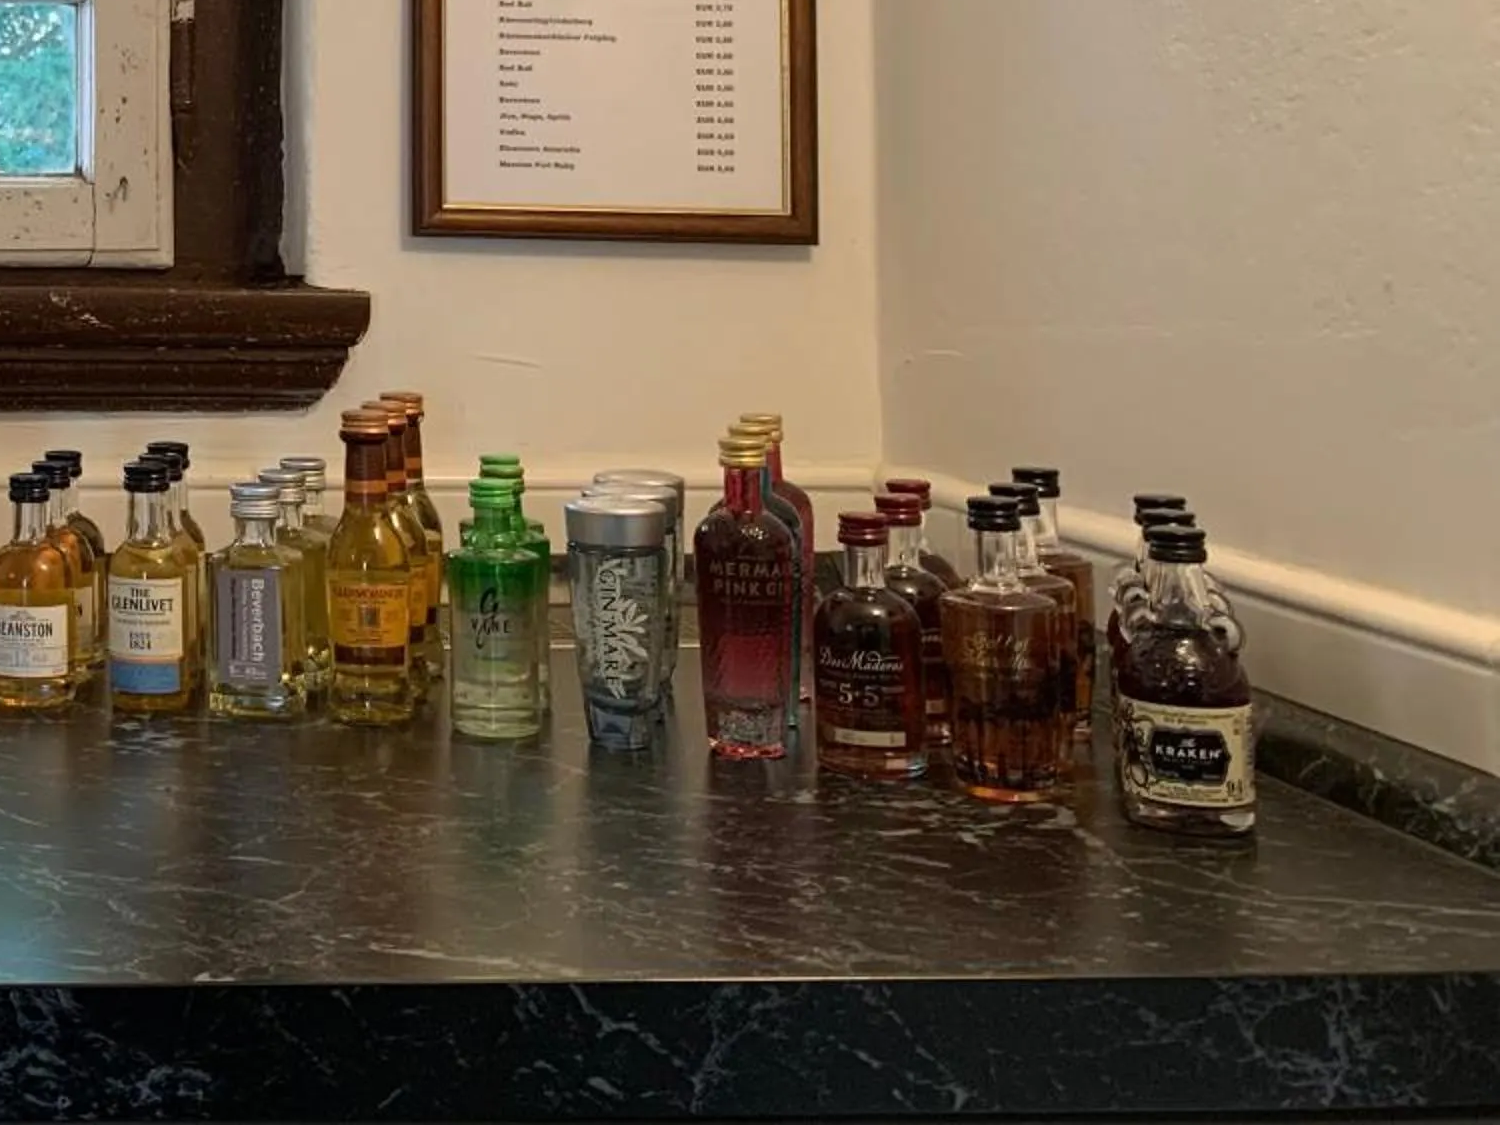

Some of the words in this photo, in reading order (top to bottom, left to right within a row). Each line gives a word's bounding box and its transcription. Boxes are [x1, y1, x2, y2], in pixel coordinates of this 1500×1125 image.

[130, 588, 151, 598] THE
[111, 594, 173, 612] GLENLIVET
[1155, 744, 1222, 760] KRAKEN
